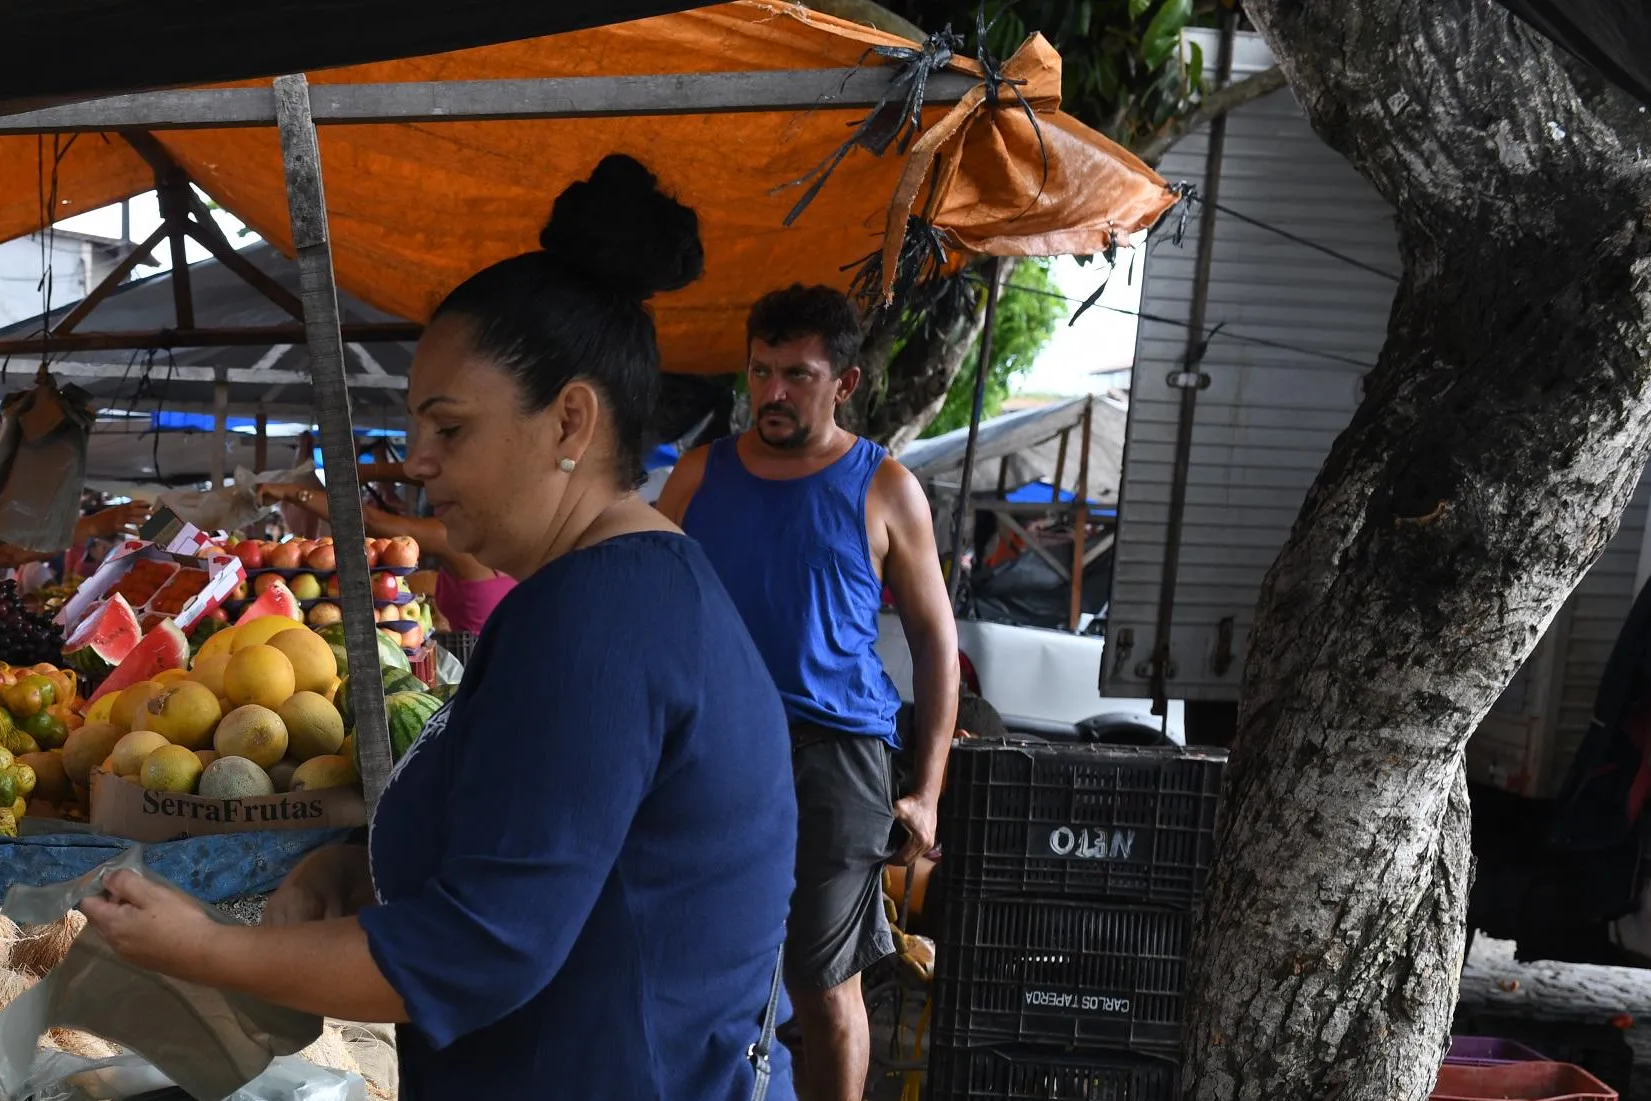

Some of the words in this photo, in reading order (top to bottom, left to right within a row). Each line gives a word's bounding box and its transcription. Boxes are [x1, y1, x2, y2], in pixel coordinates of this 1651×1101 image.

[142, 790, 324, 824] SerraFrutas
[1049, 826, 1135, 859] NETO
[1081, 995, 1130, 1013] CARLOS
